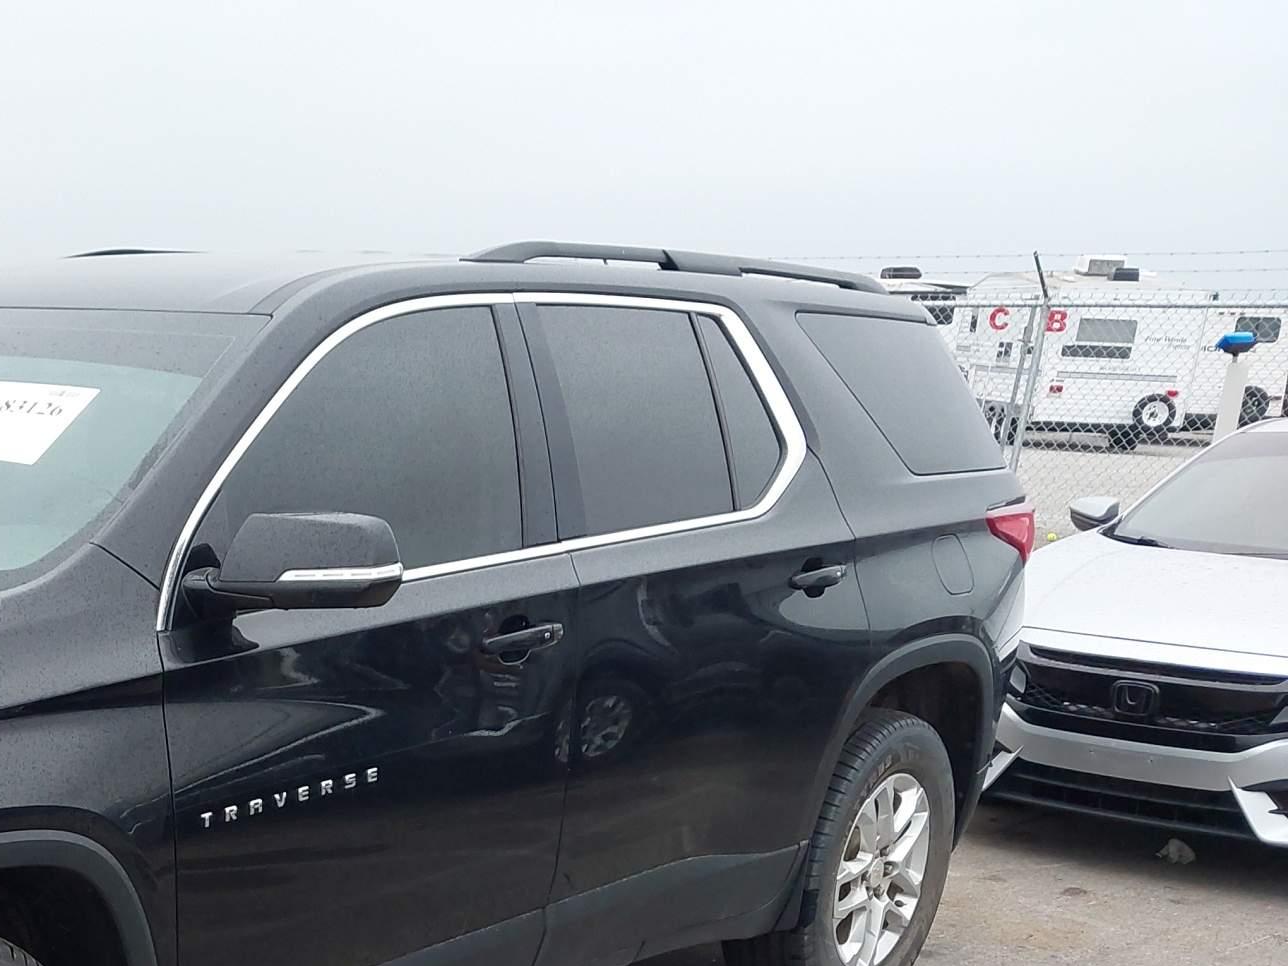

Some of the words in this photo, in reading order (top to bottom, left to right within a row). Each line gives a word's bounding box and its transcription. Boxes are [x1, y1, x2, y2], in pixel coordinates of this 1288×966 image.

[989, 307, 1010, 330] C
[1045, 309, 1068, 332] B
[200, 767, 378, 828] TRAVERSE
